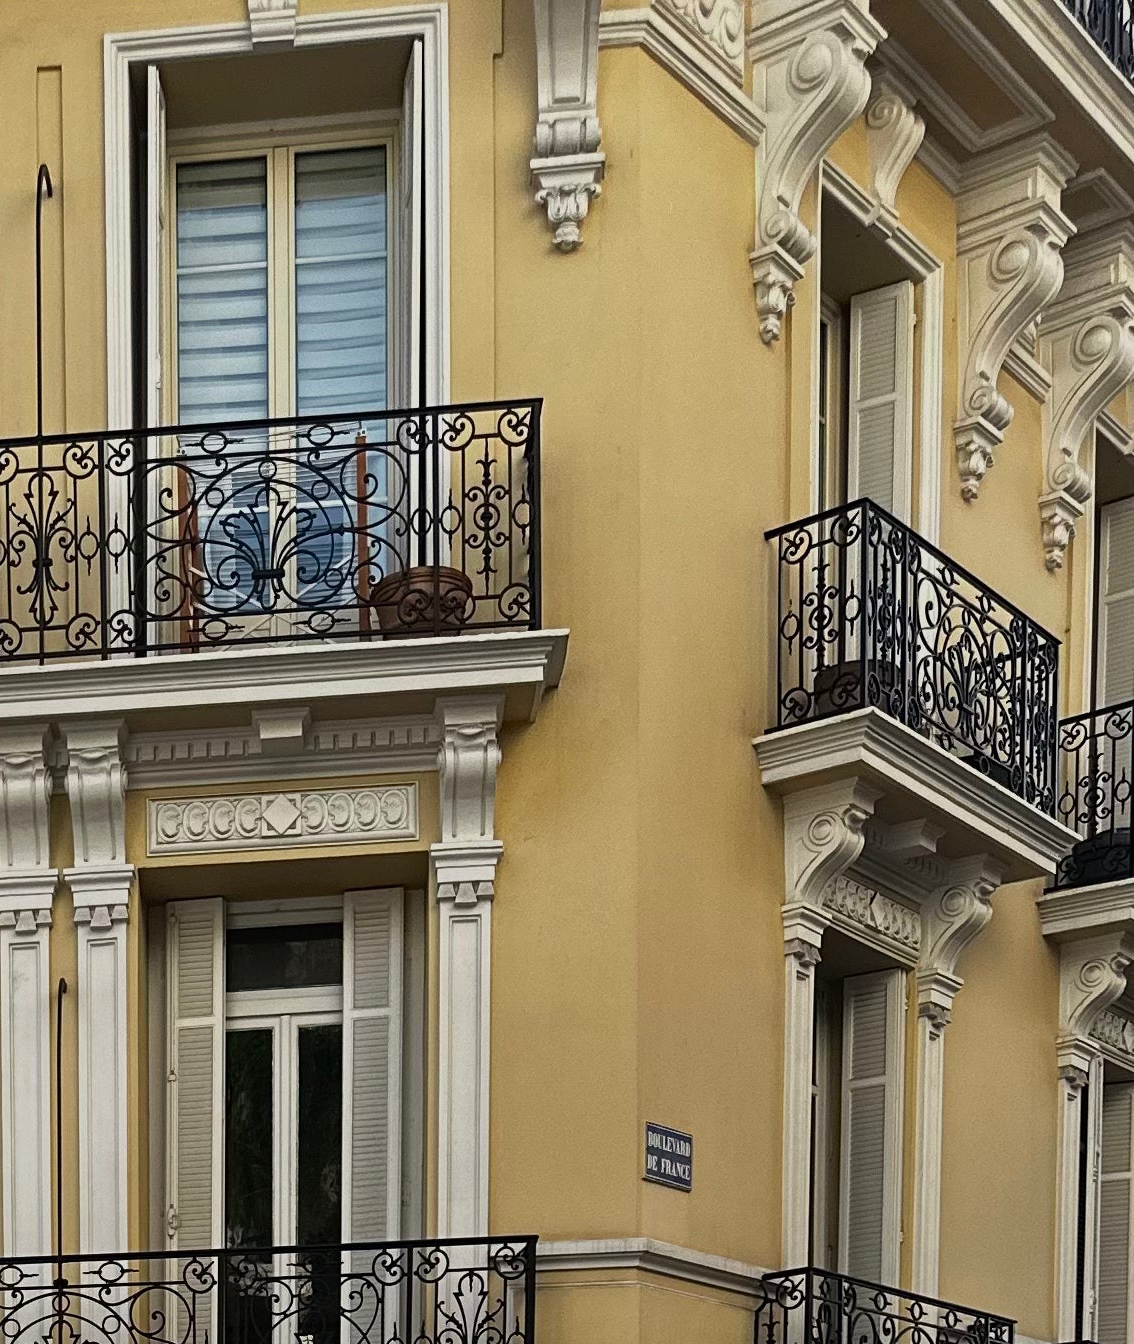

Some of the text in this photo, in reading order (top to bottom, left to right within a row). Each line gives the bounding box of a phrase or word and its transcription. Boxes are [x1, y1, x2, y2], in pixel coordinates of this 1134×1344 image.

[647, 1131, 691, 1157] BOULEVARD
[647, 1154, 691, 1180] DE FRANCE
